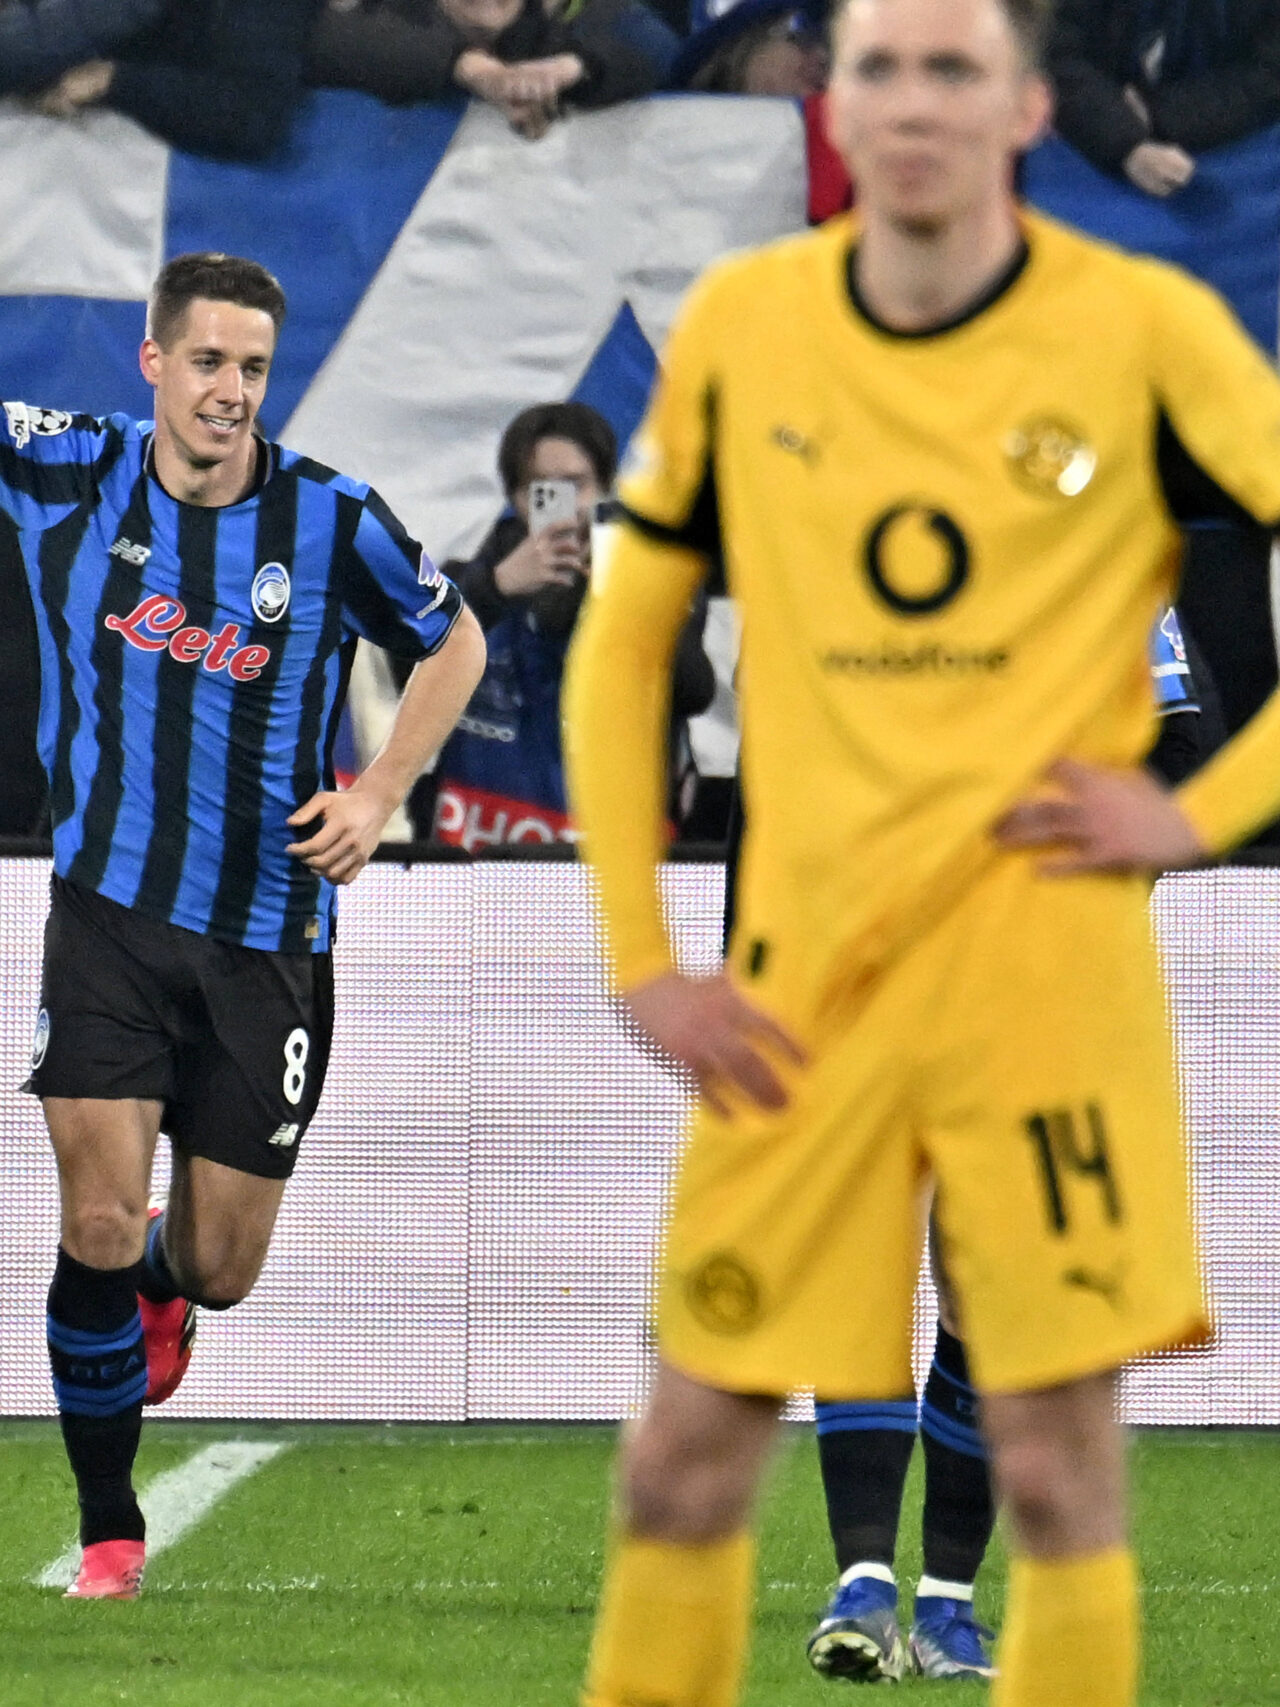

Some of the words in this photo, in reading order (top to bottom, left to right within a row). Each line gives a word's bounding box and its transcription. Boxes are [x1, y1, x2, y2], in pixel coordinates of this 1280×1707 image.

[104, 594, 270, 681] Lete
[283, 1027, 309, 1105] 8
[1024, 1098, 1124, 1235] 14
